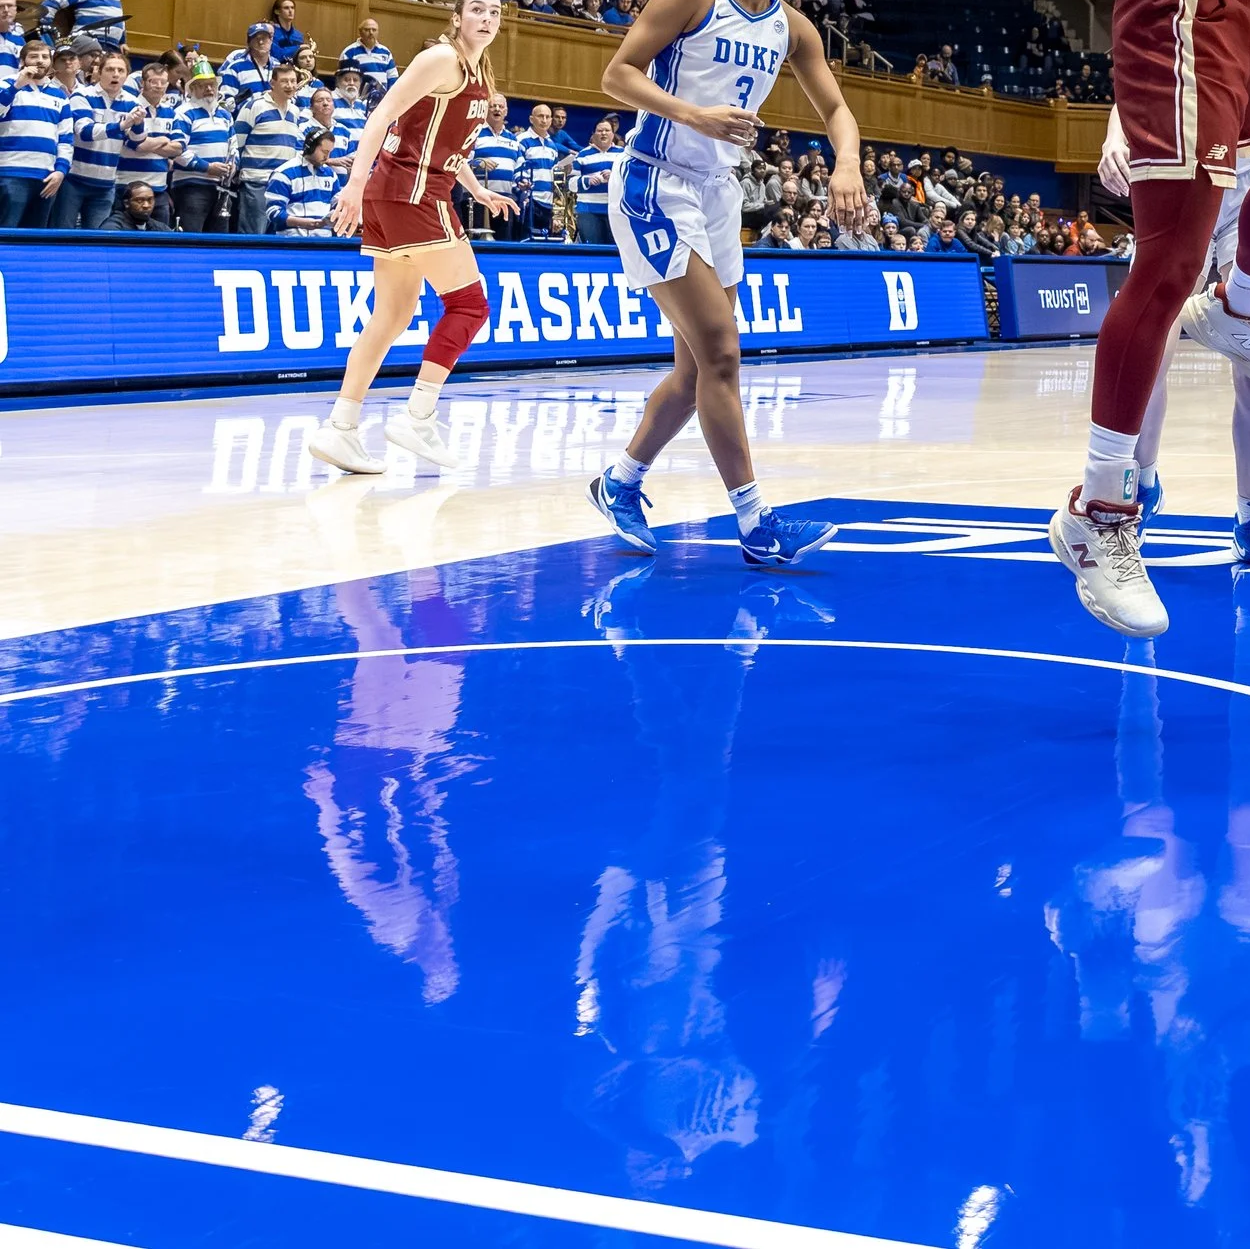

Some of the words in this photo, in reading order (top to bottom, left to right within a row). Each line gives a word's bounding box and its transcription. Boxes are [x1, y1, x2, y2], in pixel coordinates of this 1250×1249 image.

[713, 36, 780, 76] DUKE
[730, 75, 755, 111] 3
[1038, 289, 1075, 309] TRUIST
